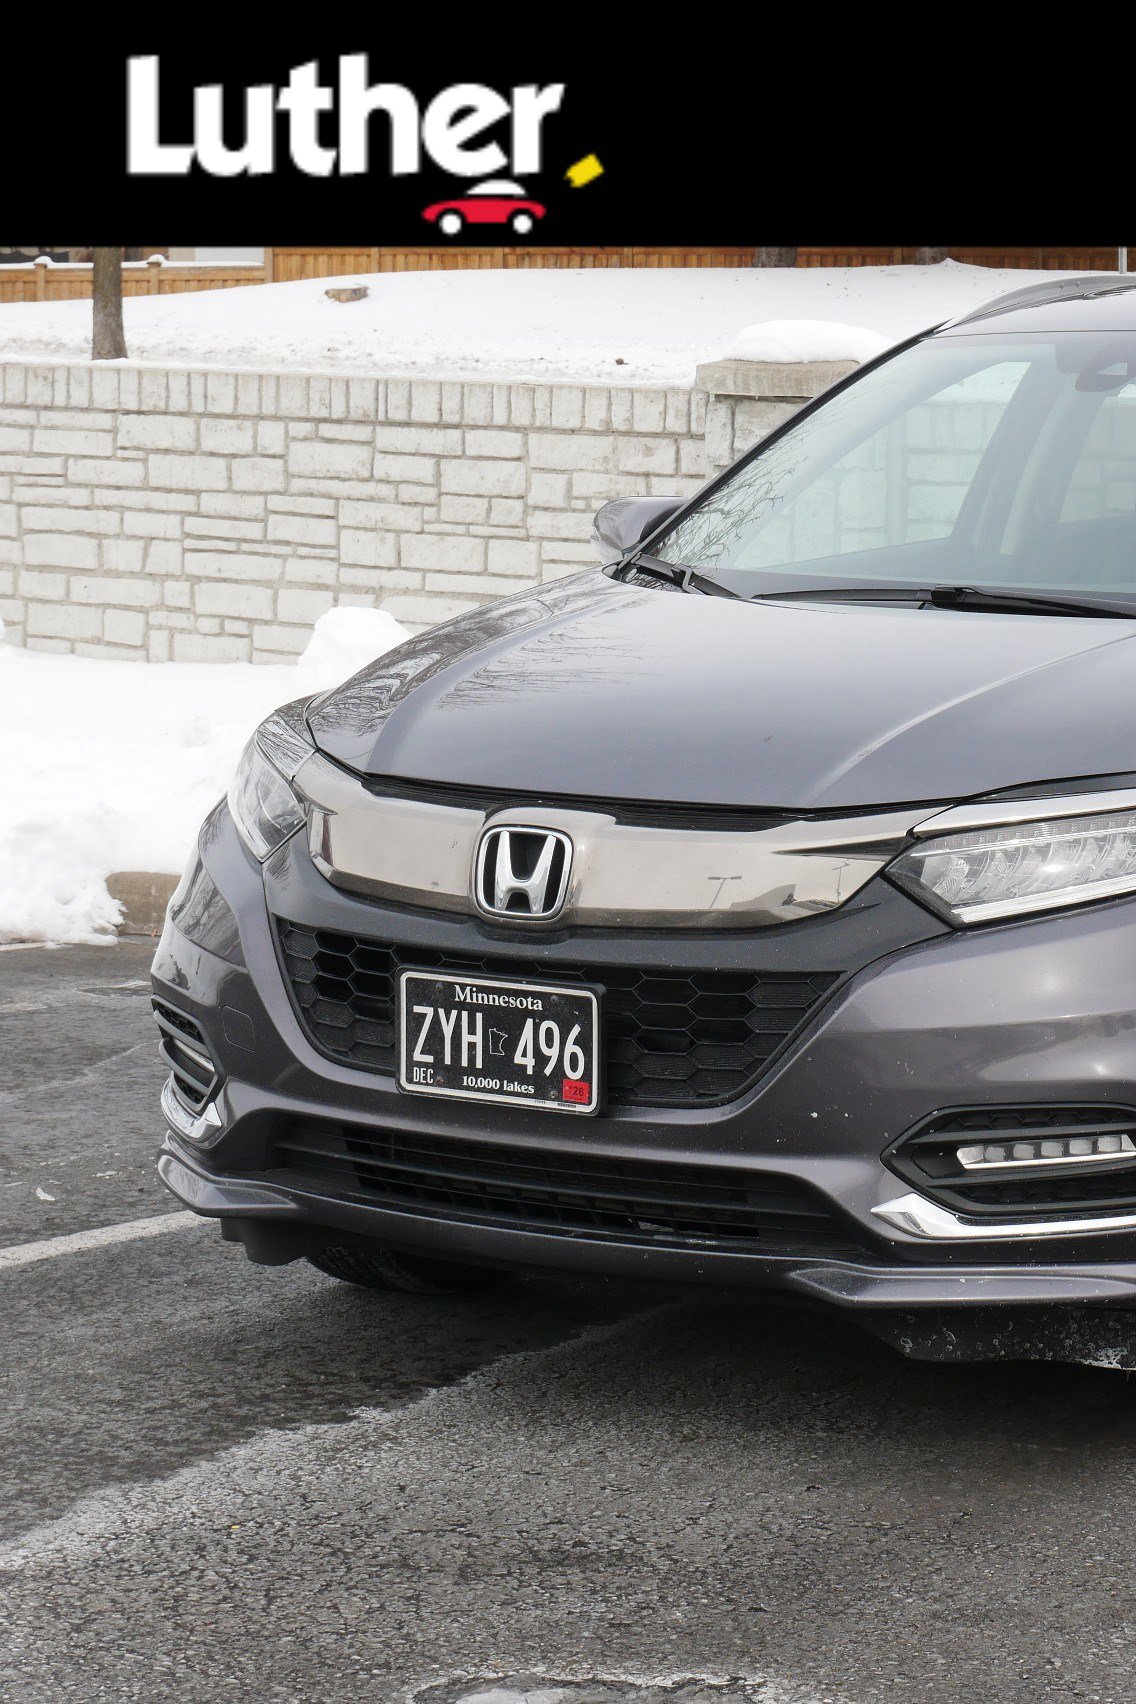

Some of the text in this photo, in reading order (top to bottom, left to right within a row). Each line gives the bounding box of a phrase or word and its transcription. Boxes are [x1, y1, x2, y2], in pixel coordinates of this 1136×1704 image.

[454, 985, 543, 1011] Minnesota
[413, 1005, 585, 1080] ZYH 496
[413, 1066, 434, 1084] DEC
[462, 1075, 535, 1094] 10,000 lakes
